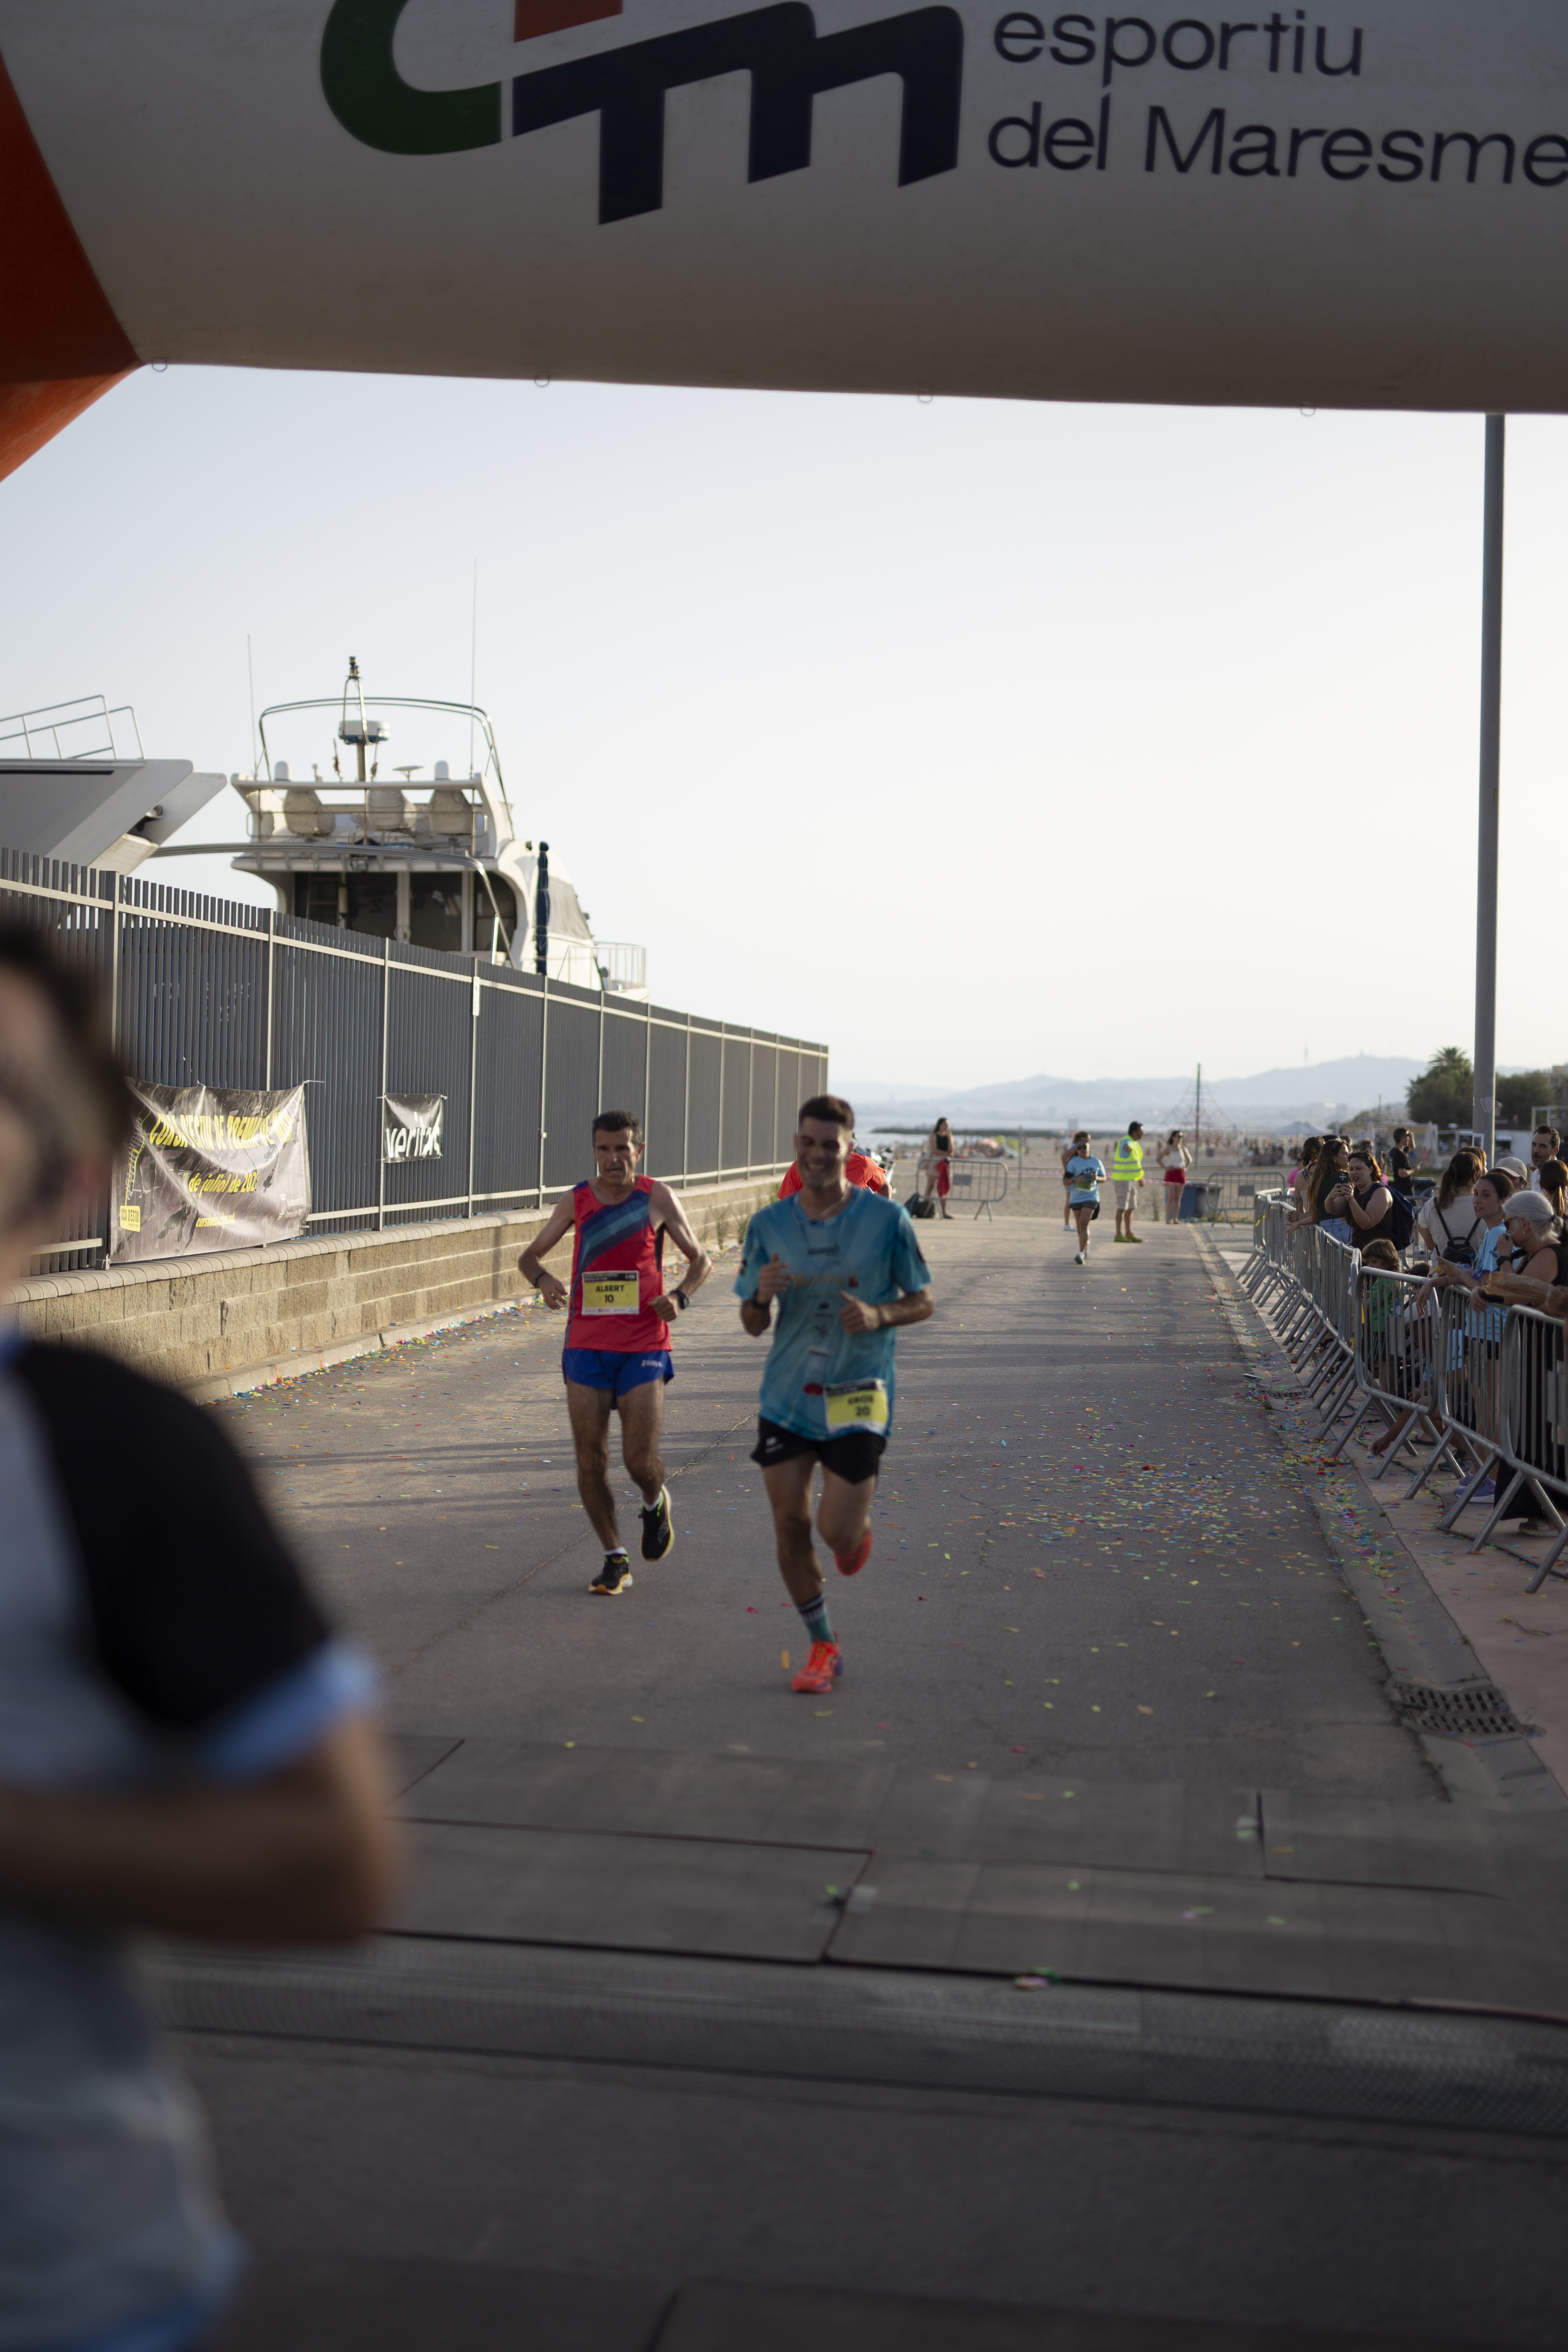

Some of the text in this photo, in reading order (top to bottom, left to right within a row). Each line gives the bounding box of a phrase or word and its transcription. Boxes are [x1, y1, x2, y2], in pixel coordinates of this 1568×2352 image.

[994, 9, 1363, 89] esportiu
[988, 92, 1568, 187] del Maresme
[180, 1114, 214, 1151] D'ESTIU
[214, 1115, 227, 1151] DE
[386, 1111, 440, 1159] veritas
[189, 1173, 202, 1192] de
[199, 1173, 232, 1198] juliol
[228, 1173, 241, 1193] de
[604, 1294, 614, 1303] 10
